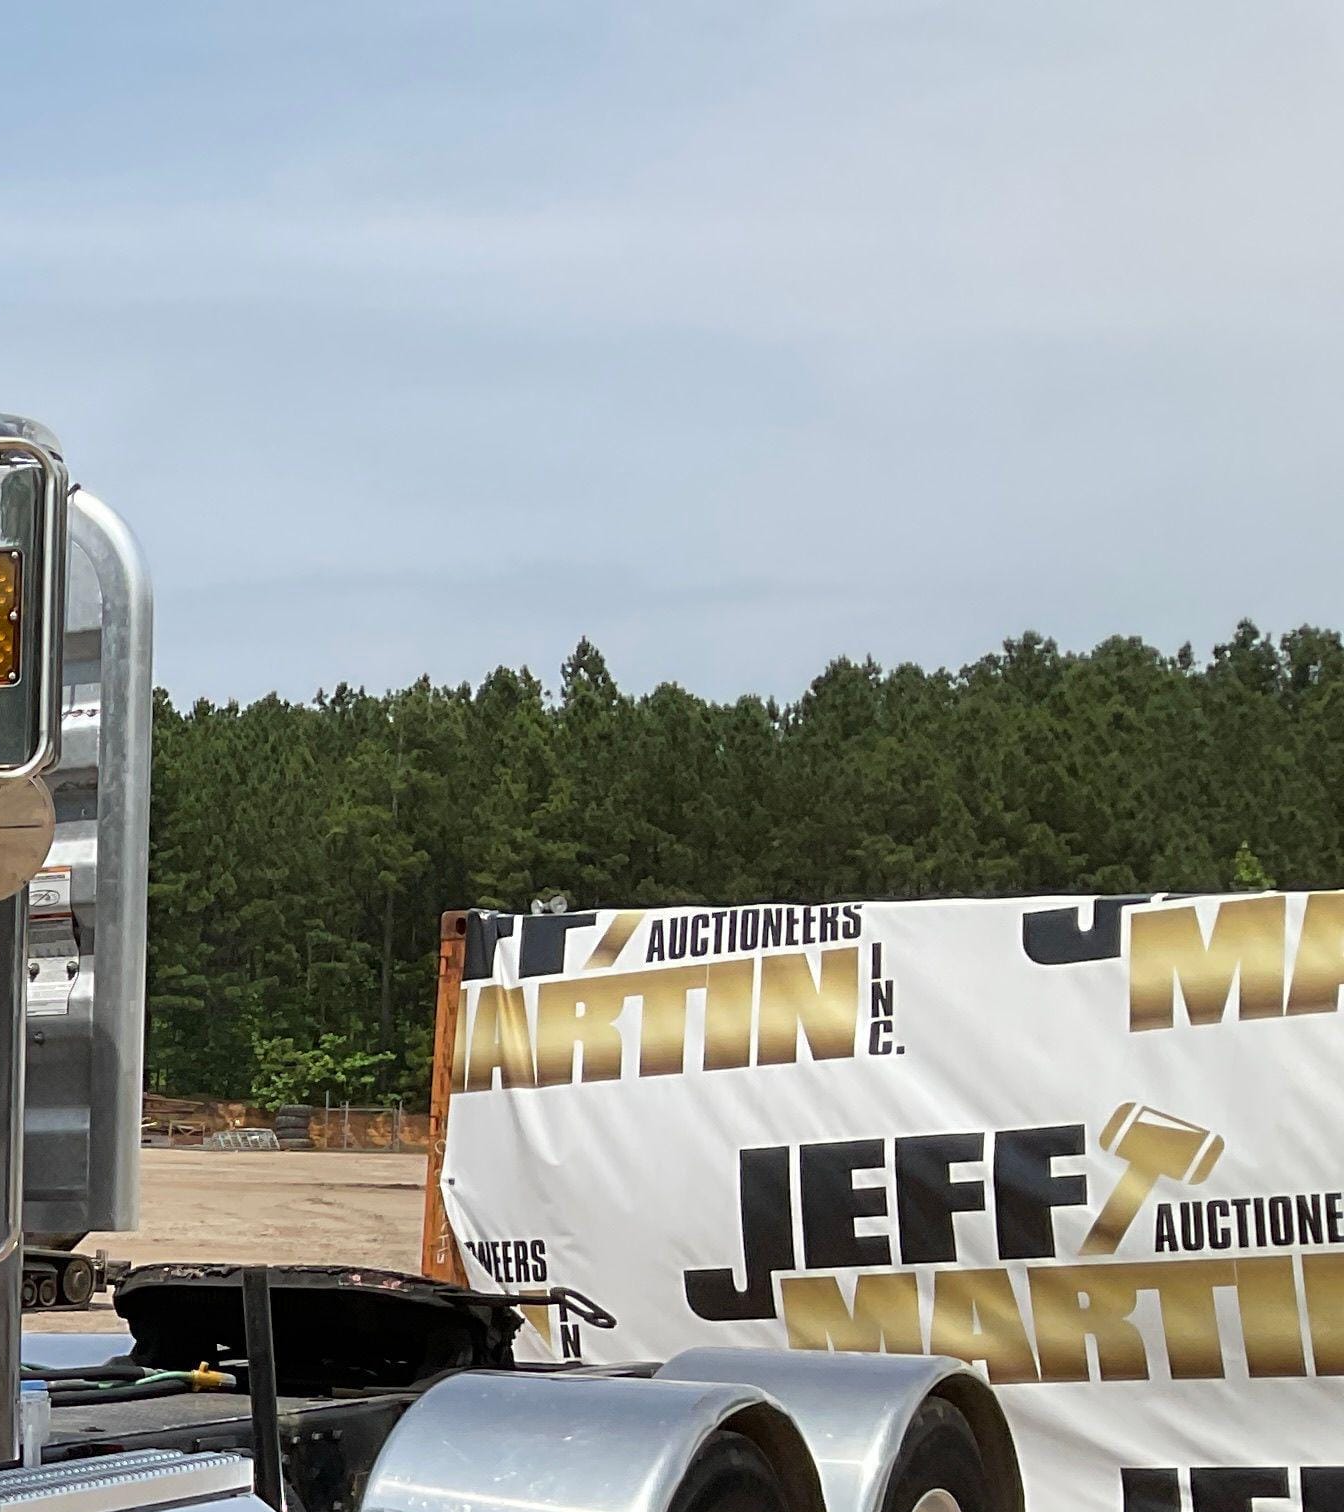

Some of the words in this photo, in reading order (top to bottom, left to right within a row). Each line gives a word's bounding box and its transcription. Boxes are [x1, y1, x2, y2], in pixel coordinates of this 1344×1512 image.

[645, 903, 863, 963] AUCTIONEERS
[452, 946, 859, 1092] ARTIN
[464, 1239, 548, 1283] NEERS
[685, 1124, 1088, 1322] JEFF
